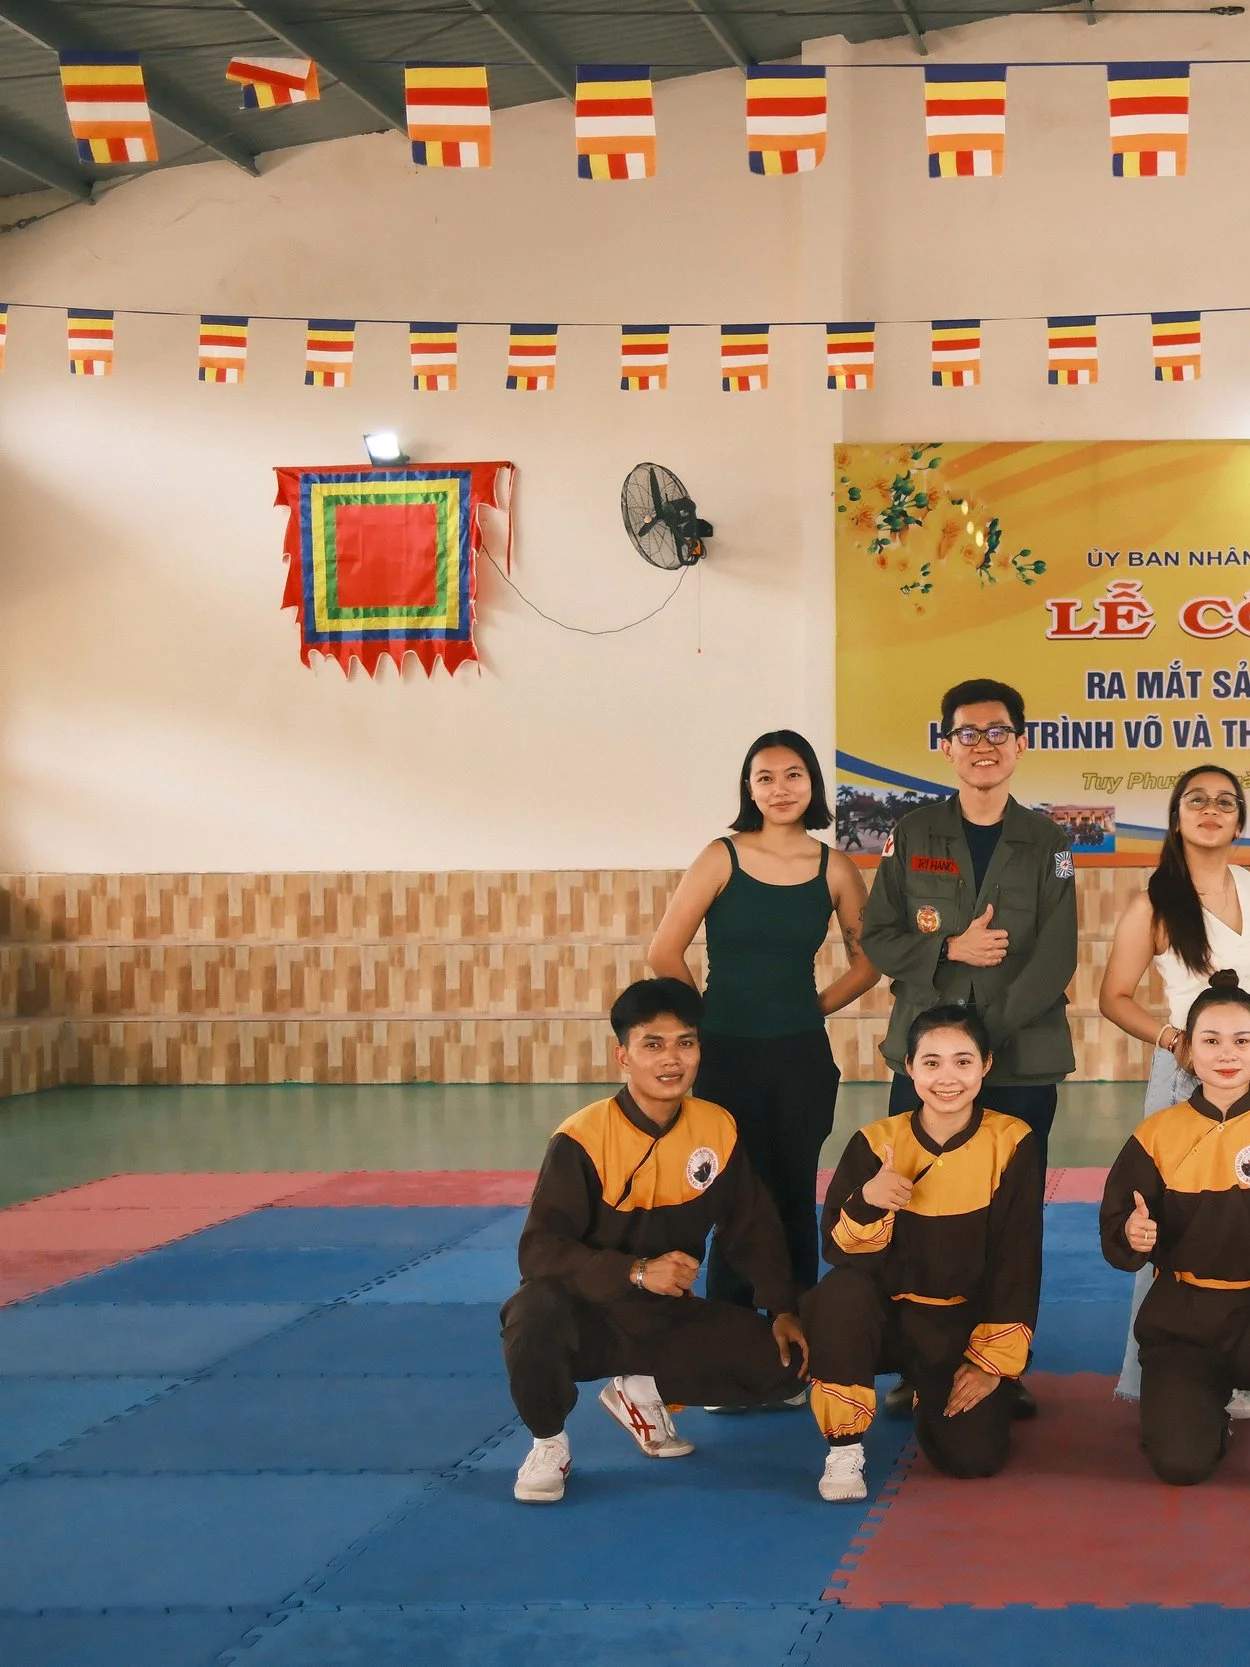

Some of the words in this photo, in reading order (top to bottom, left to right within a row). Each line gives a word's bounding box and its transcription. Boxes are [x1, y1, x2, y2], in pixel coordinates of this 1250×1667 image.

[1087, 548, 1121, 567] ỦY
[1128, 551, 1180, 567] BAN
[1047, 580, 1156, 638] LỄ
[1087, 671, 1126, 699] RA
[1137, 660, 1202, 699] MẮT
[1025, 715, 1114, 749] TRÌNH
[1124, 715, 1162, 748] VÕ
[1173, 714, 1212, 748] VÀ
[1082, 772, 1123, 794] Tuy
[1127, 771, 1185, 790] Phư
